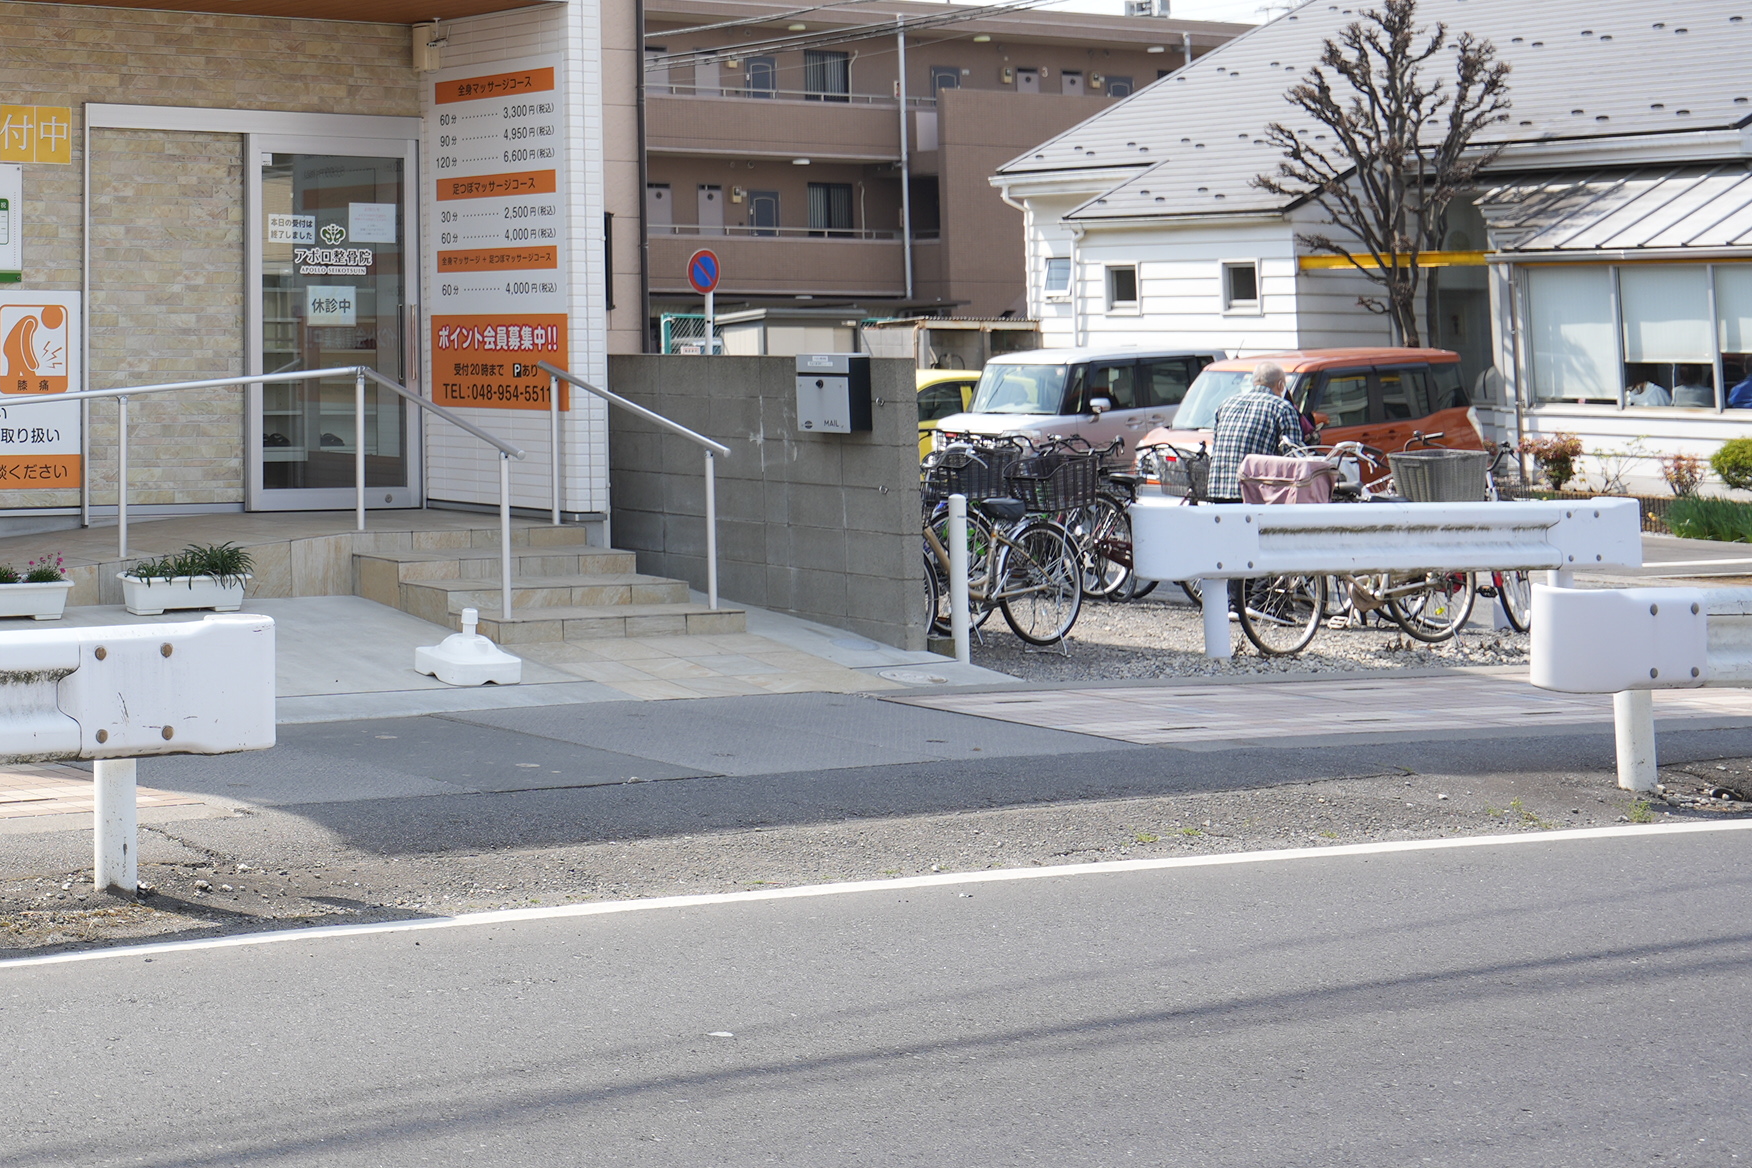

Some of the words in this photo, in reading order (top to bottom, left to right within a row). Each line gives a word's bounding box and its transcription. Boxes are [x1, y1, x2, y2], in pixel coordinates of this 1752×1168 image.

[458, 76, 532, 97] 全身マッサージコース
[440, 114, 457, 126] 60分
[440, 135, 457, 147] 90分
[436, 157, 457, 169] 120分
[452, 177, 535, 195] 足つぼマッサージコース
[270, 218, 313, 228] 本日の受付は
[441, 211, 458, 223] 30分
[270, 230, 313, 240] 終了しました
[441, 233, 458, 244] 60分
[294, 248, 372, 266] アポロ整骨院
[300, 266, 328, 274] APOLLO
[442, 284, 459, 296] 60分
[311, 298, 351, 313] 休診中
[438, 325, 558, 350] ポイント会員募集中!!
[454, 363, 505, 377] 受付20時まで
